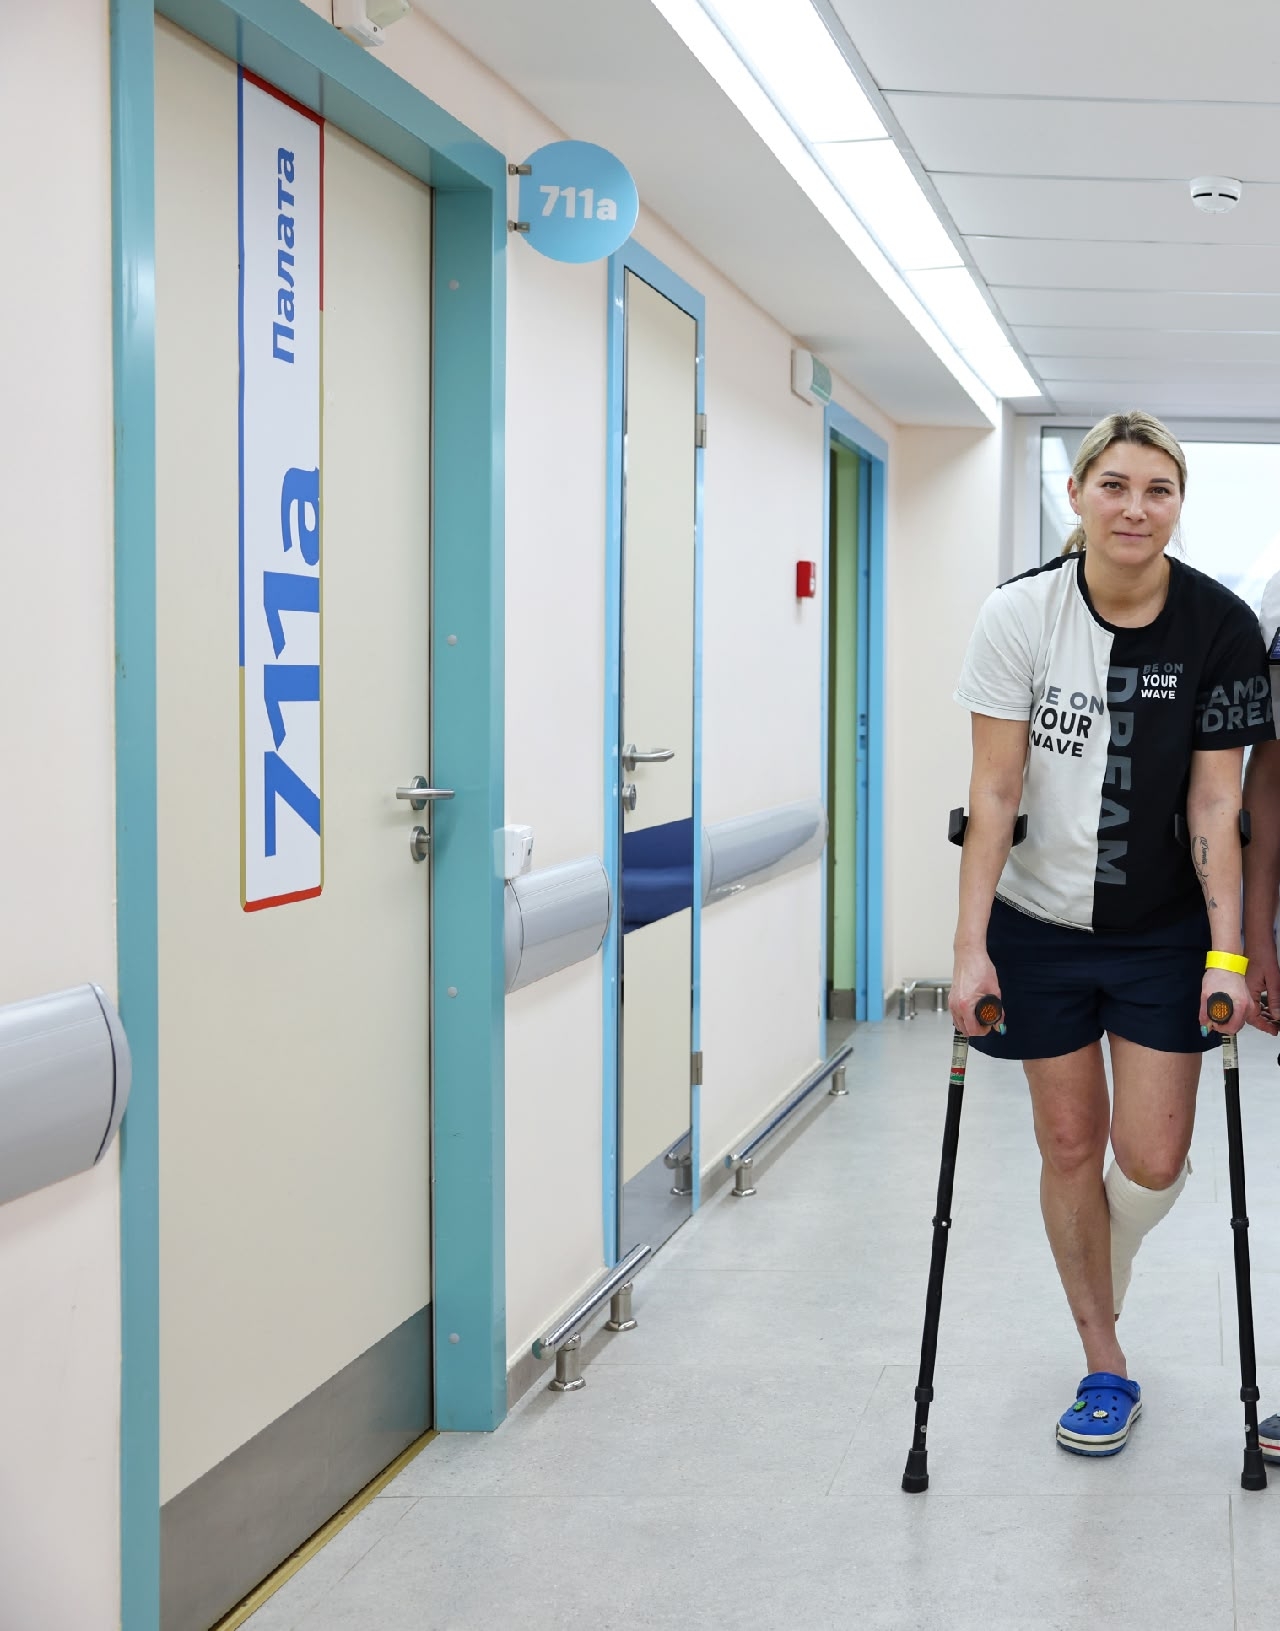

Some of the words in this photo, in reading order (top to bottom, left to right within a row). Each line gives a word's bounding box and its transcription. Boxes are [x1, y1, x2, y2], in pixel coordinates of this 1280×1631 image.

[539, 185, 617, 221] 711а
[272, 146, 295, 364] Палата
[263, 466, 321, 858] 711а
[1142, 663, 1160, 675] BE
[1163, 662, 1184, 674] ON
[1141, 689, 1176, 699] WAVE
[1142, 674, 1178, 688] YOUR
[1040, 685, 1062, 706] E
[1070, 691, 1105, 716] ON
